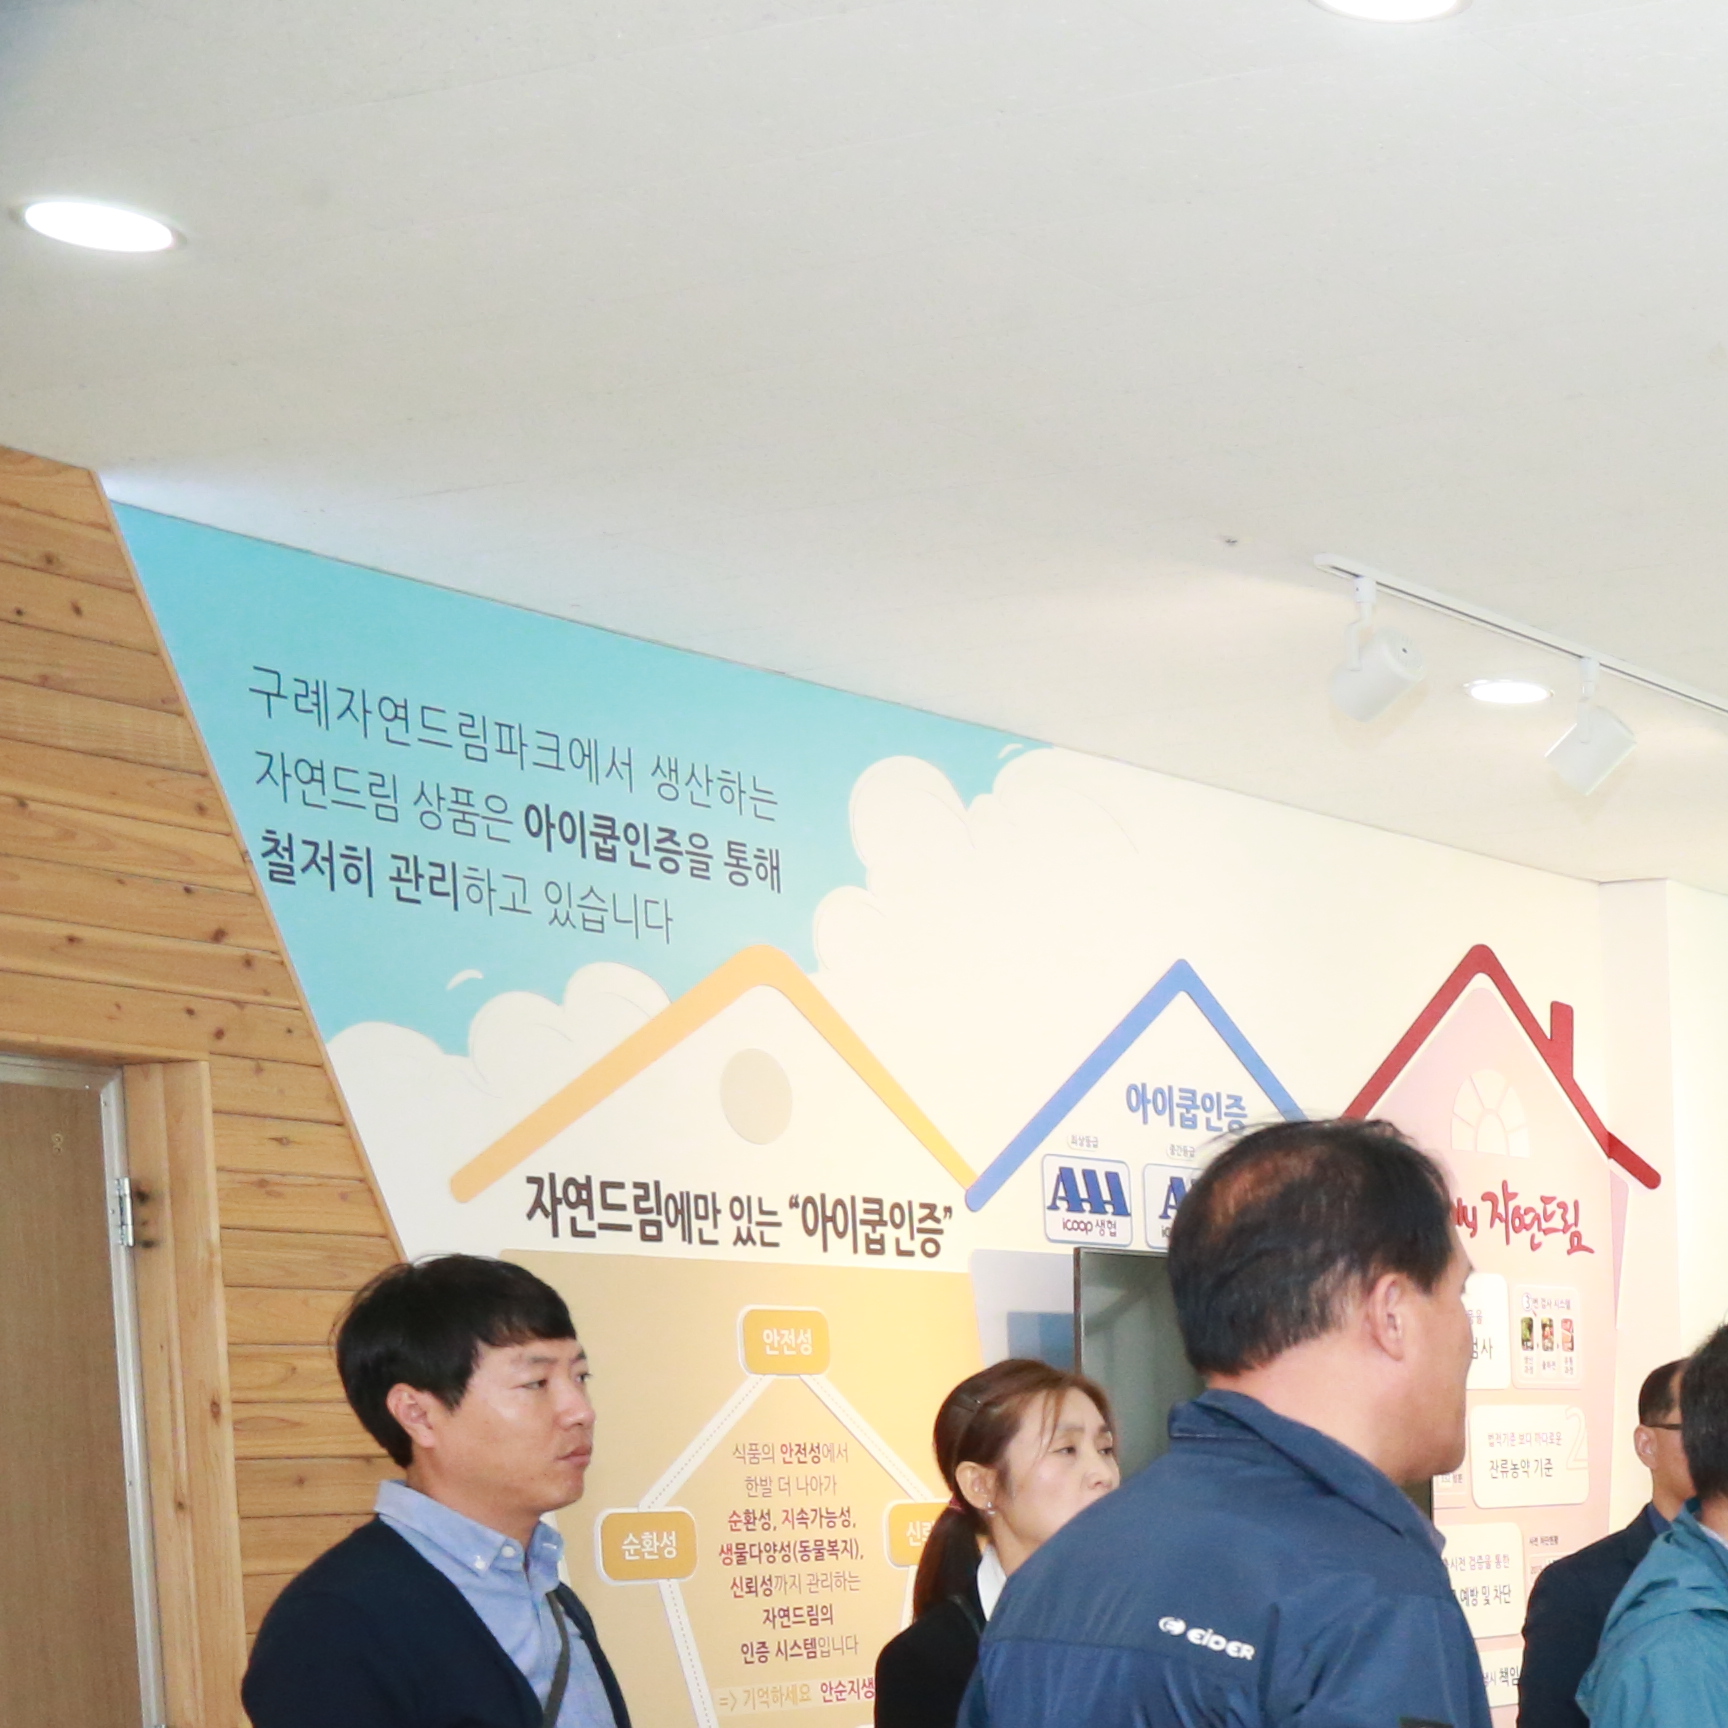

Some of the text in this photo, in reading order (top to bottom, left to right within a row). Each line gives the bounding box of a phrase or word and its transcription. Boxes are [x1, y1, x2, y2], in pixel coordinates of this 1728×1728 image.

[248, 664, 779, 822] 구례자연드림파크에서 생산하는
[255, 750, 784, 894] 자연드림 상품은 아이쿱인증을 통해
[260, 828, 674, 945] 철저히 관리하고 있습니다
[1125, 1082, 1248, 1134] 아이쿱인증
[1046, 1166, 1131, 1217] AAA
[525, 1172, 721, 1247] 자연드림에만
[729, 1197, 783, 1249] 있는
[1480, 1179, 1596, 1256] 자연드림
[1095, 1219, 1117, 1238] 생협
[762, 1326, 814, 1356] 안전성
[733, 1441, 850, 1466] 식품의 안전성에서
[1489, 1458, 1554, 1480] 잔류농약 기준
[745, 1474, 838, 1498] 한발 더 나아가
[728, 1506, 857, 1533] 순환성, 지속가능성,
[621, 1529, 678, 1561] 순환성
[718, 1537, 865, 1567] 생물다양성(동물복지),
[730, 1570, 862, 1599] 신뢰성까지 관리하는
[1460, 1583, 1512, 1607] 예방 및 차단
[762, 1604, 834, 1629] 자연드림의
[740, 1635, 860, 1665] 인증 시스템입니다
[742, 1683, 812, 1711] 기억하세요
